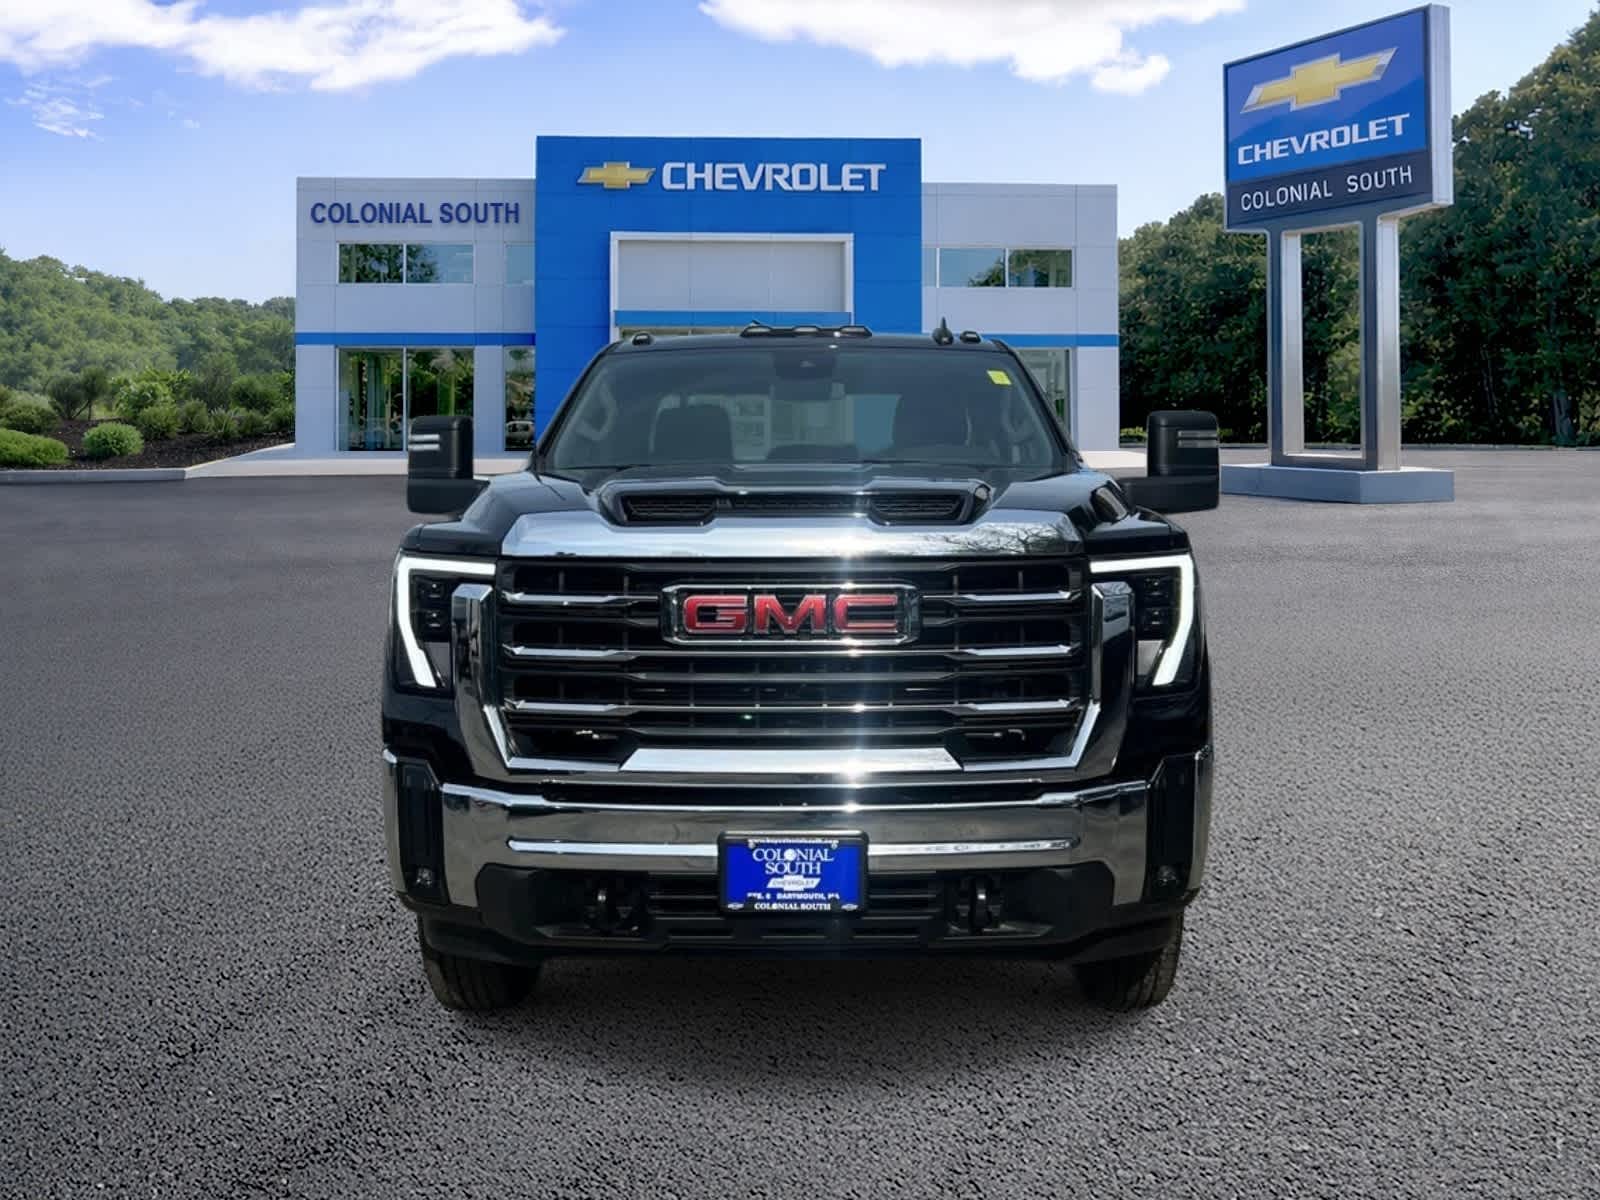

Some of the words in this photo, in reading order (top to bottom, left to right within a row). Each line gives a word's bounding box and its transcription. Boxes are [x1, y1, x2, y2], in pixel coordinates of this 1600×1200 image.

[1237, 113, 1410, 165] CHEVROLET
[662, 161, 887, 191] CHEVROLET
[1241, 180, 1333, 211] COLONIAL
[1346, 165, 1413, 193] SOUTH
[310, 202, 432, 224] COLONIAL
[439, 202, 520, 224] SOUTH
[683, 595, 899, 634] GMC
[752, 848, 834, 862] COLONIAL
[765, 862, 821, 875] SOUTH
[754, 902, 799, 911] COLONIAL
[800, 902, 831, 911] SOUTH
